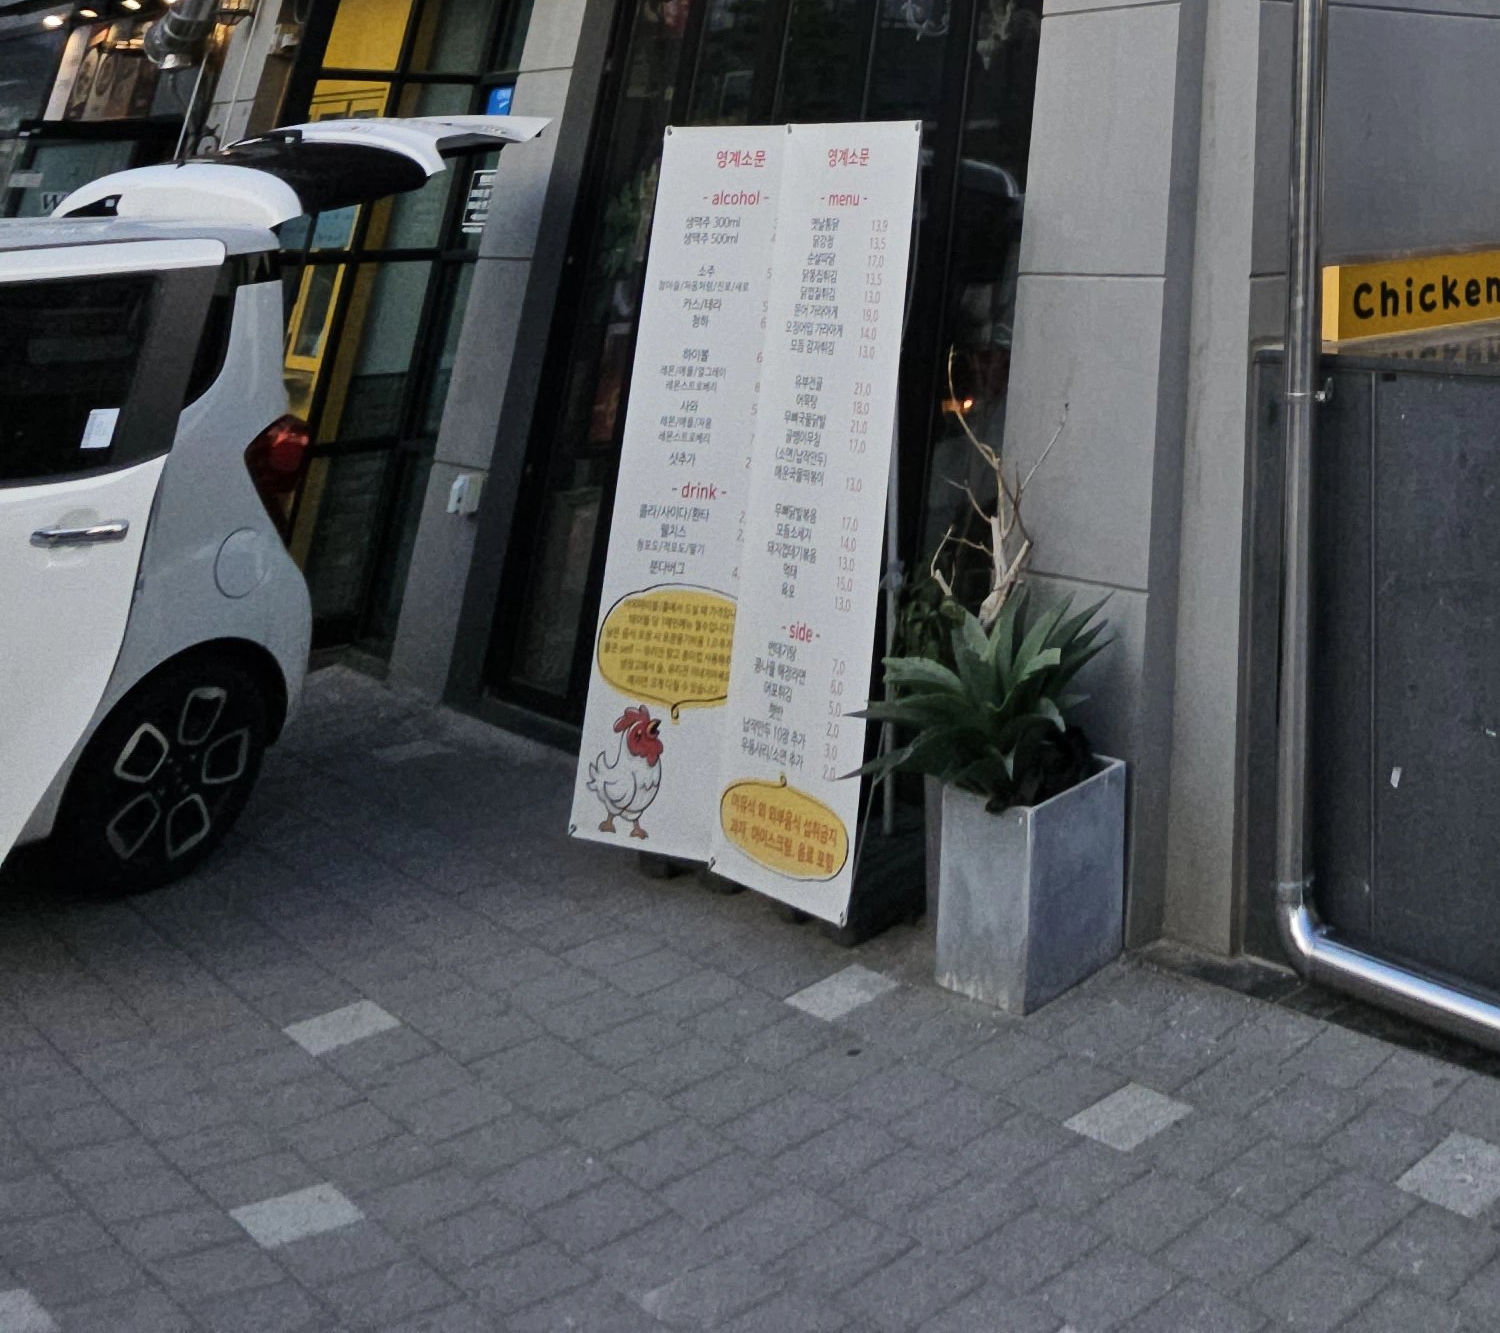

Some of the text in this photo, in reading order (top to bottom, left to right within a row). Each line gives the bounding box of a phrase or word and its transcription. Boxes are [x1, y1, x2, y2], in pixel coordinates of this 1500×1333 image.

[716, 149, 765, 168] 영계소문
[828, 147, 870, 167] 영계소문
[711, 190, 760, 205] alcohol
[828, 193, 860, 206] menu
[685, 216, 740, 228] 생맥주 300ml
[683, 232, 739, 245] 생맥주 500ml
[697, 265, 715, 276] 소주
[682, 298, 722, 311] 카스/테라
[682, 348, 709, 361] 하이볼
[680, 481, 717, 500] drink
[789, 619, 813, 644] side
